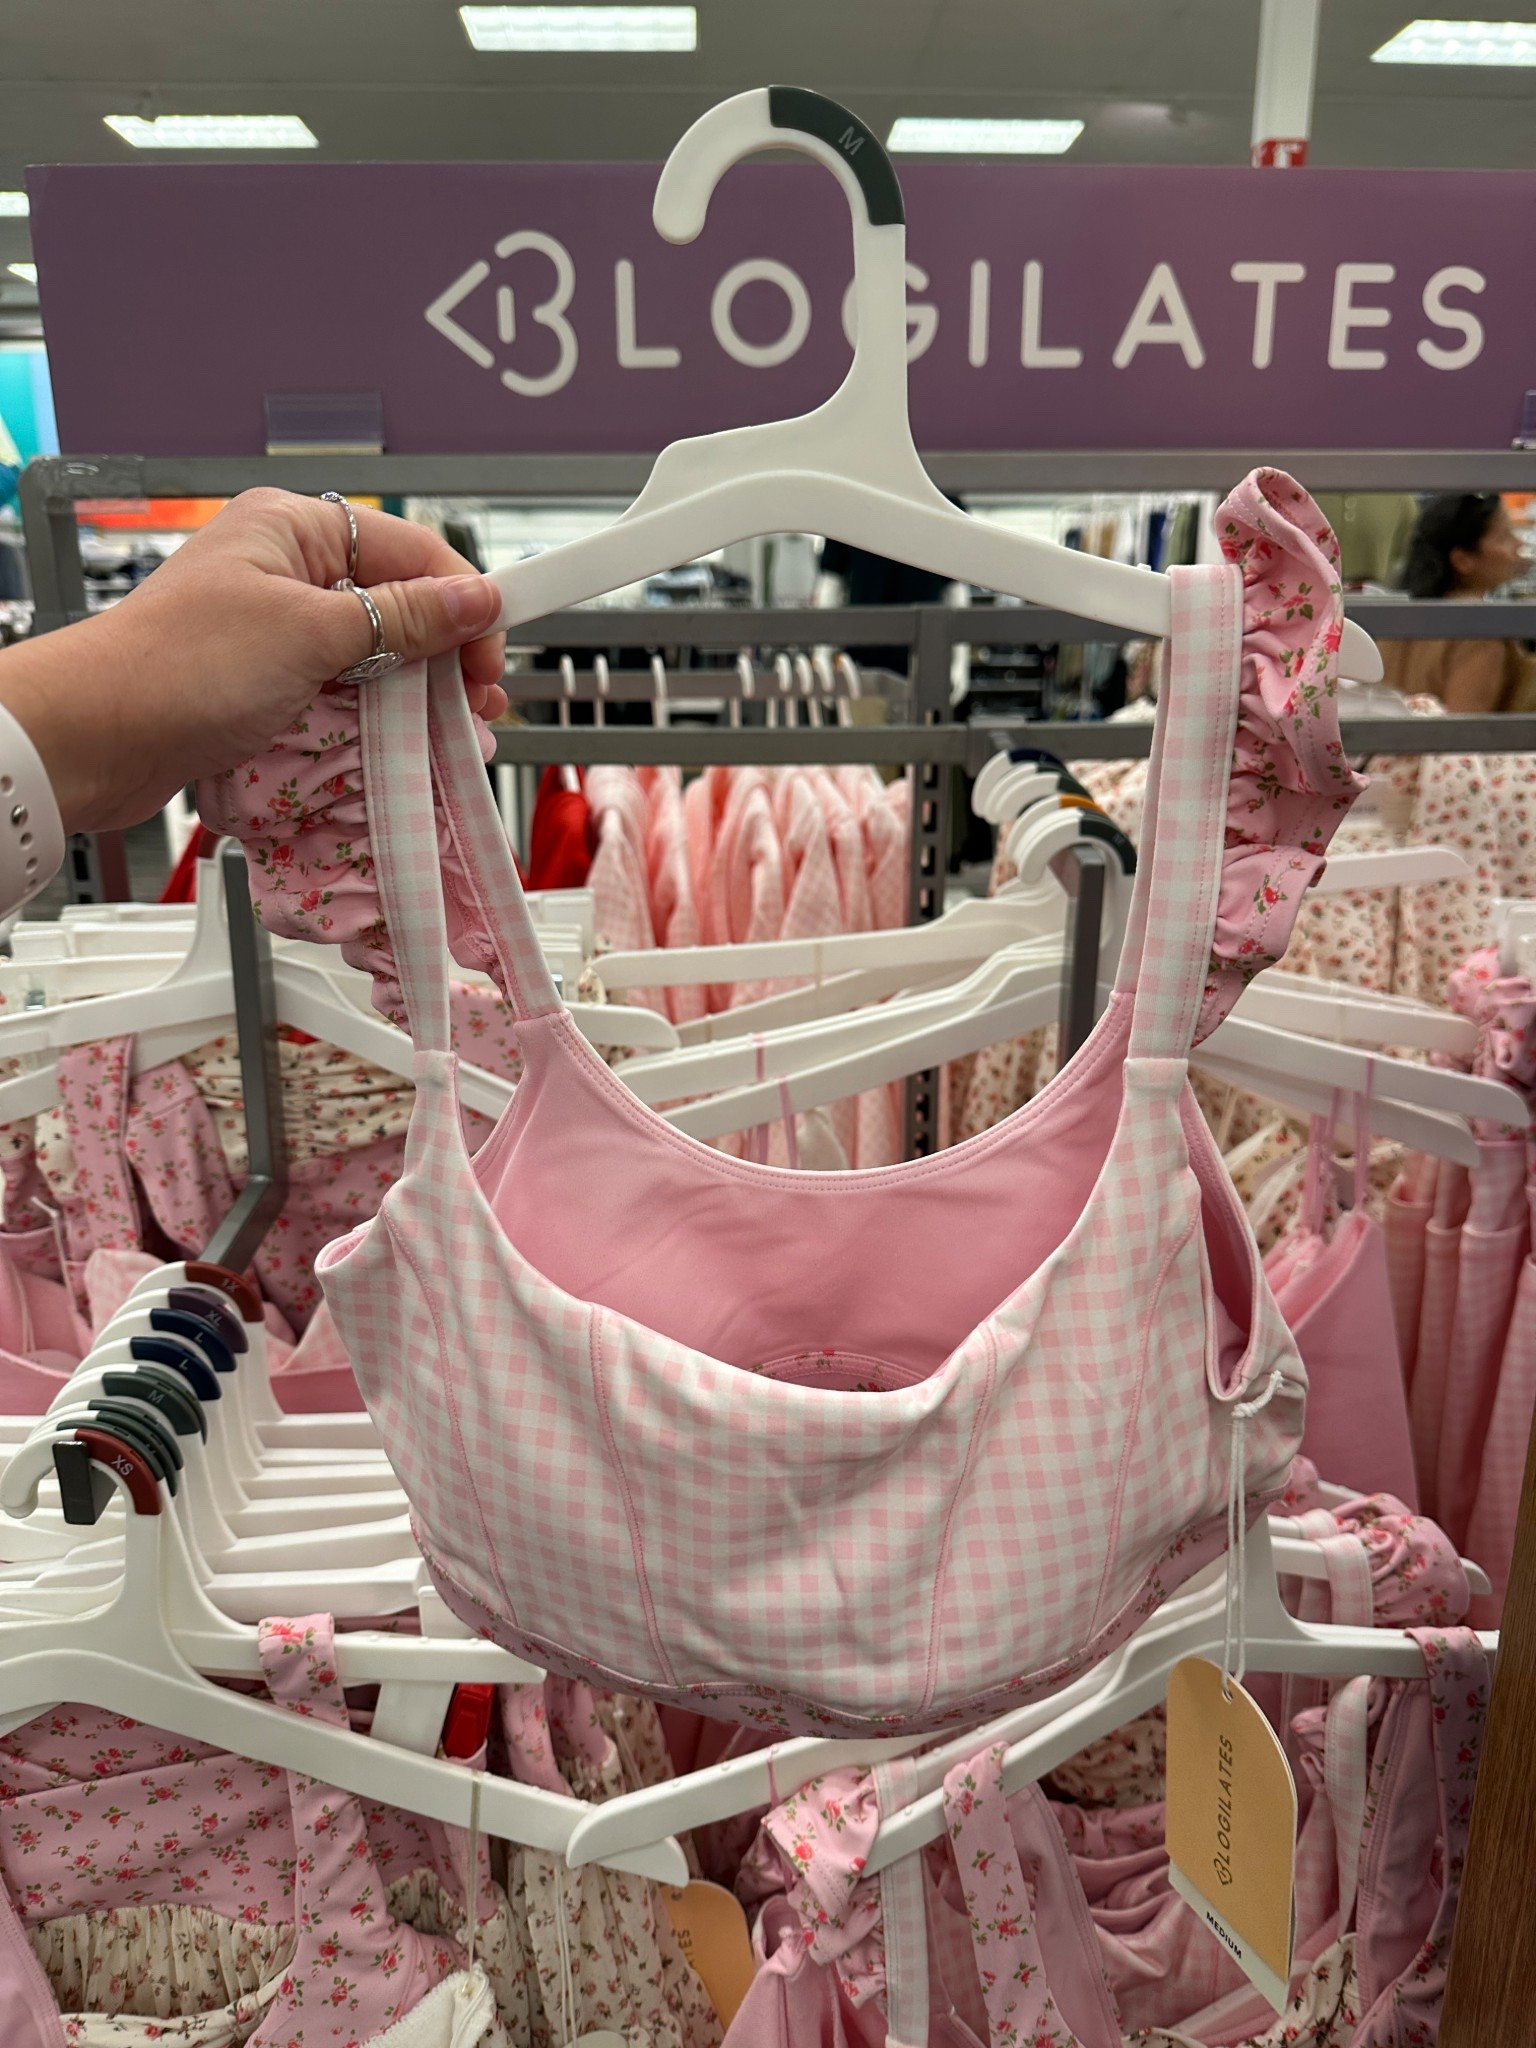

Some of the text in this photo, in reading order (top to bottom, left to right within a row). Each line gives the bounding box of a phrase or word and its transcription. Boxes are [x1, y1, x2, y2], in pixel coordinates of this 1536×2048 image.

[838, 125, 866, 156] M
[222, 1277, 240, 1293] 1X
[207, 1310, 223, 1327] XL
[195, 1332, 204, 1343] L
[179, 1359, 189, 1371] L
[149, 1391, 164, 1404] M
[111, 1454, 135, 1477] XS
[1213, 1734, 1233, 1886] BLOGILATES
[1206, 1911, 1242, 1959] MEDIUM
